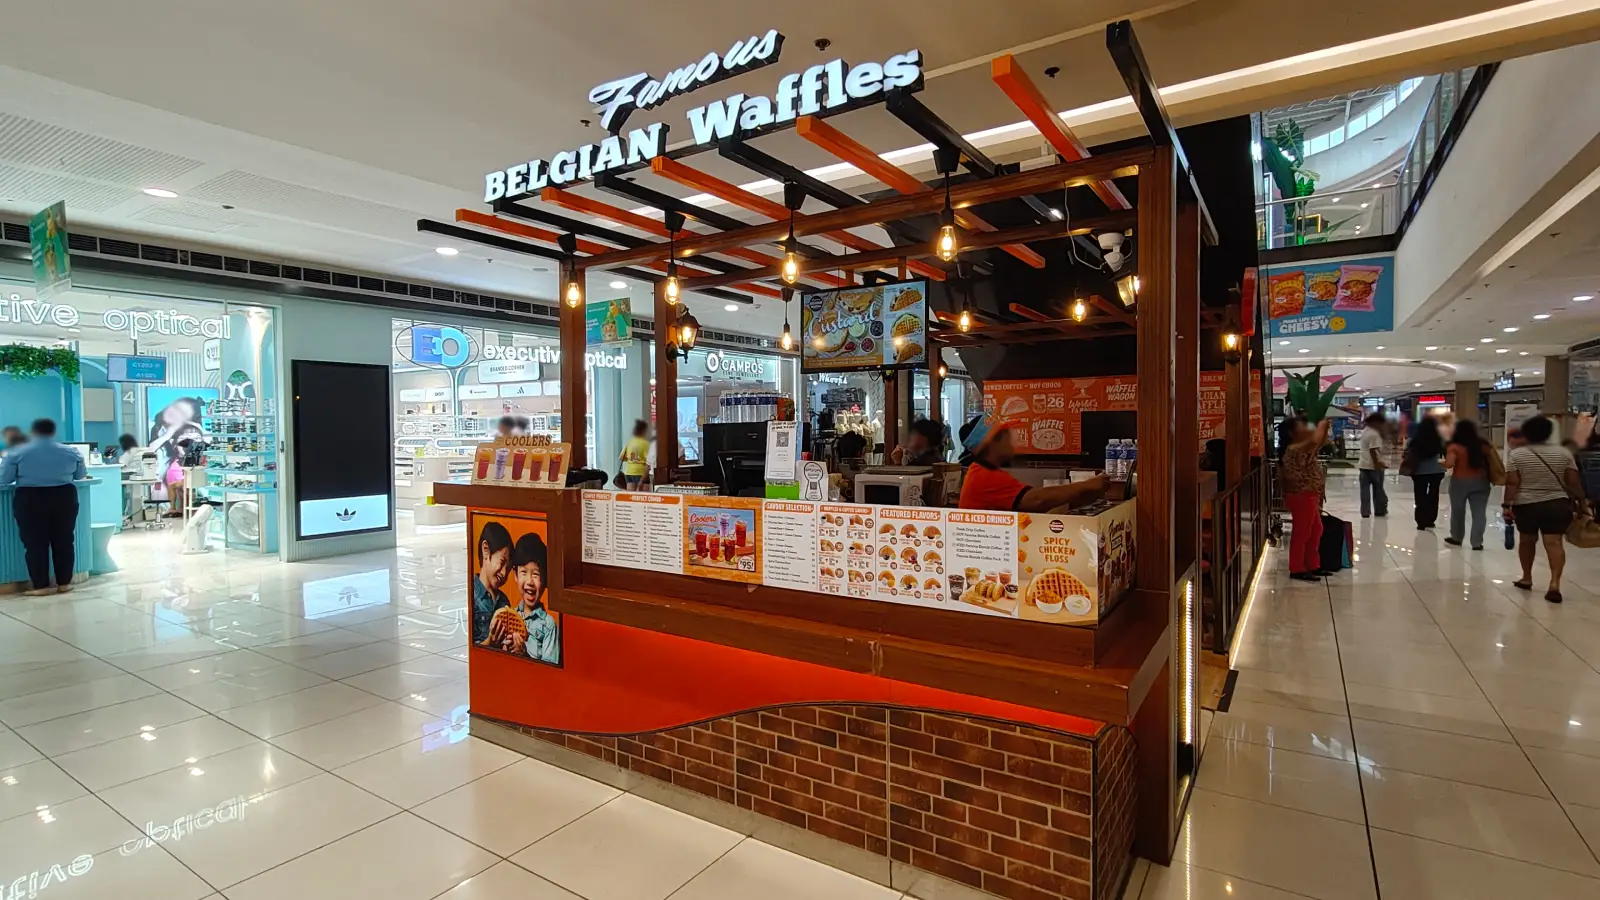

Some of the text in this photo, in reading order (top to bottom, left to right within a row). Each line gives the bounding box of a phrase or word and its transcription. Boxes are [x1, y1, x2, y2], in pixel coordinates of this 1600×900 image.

[589, 29, 779, 131] Famous
[484, 49, 924, 202] BELGIAN Waffles
[103, 308, 231, 340] optical
[808, 301, 877, 338] Custard
[1280, 319, 1329, 333] CHEESY
[1106, 384, 1137, 393] WAFFLE
[122, 391, 135, 403] 4
[1047, 397, 1064, 408] 26
[505, 434, 552, 446] COOLERS
[786, 503, 810, 512] SELECTION
[690, 512, 717, 524] Coolers
[971, 514, 986, 522] ICED
[987, 515, 1011, 524] DRINKS
[1044, 536, 1070, 546] SPICY
[1039, 546, 1076, 556] CHICKEN
[1045, 555, 1068, 564] FLOSS
